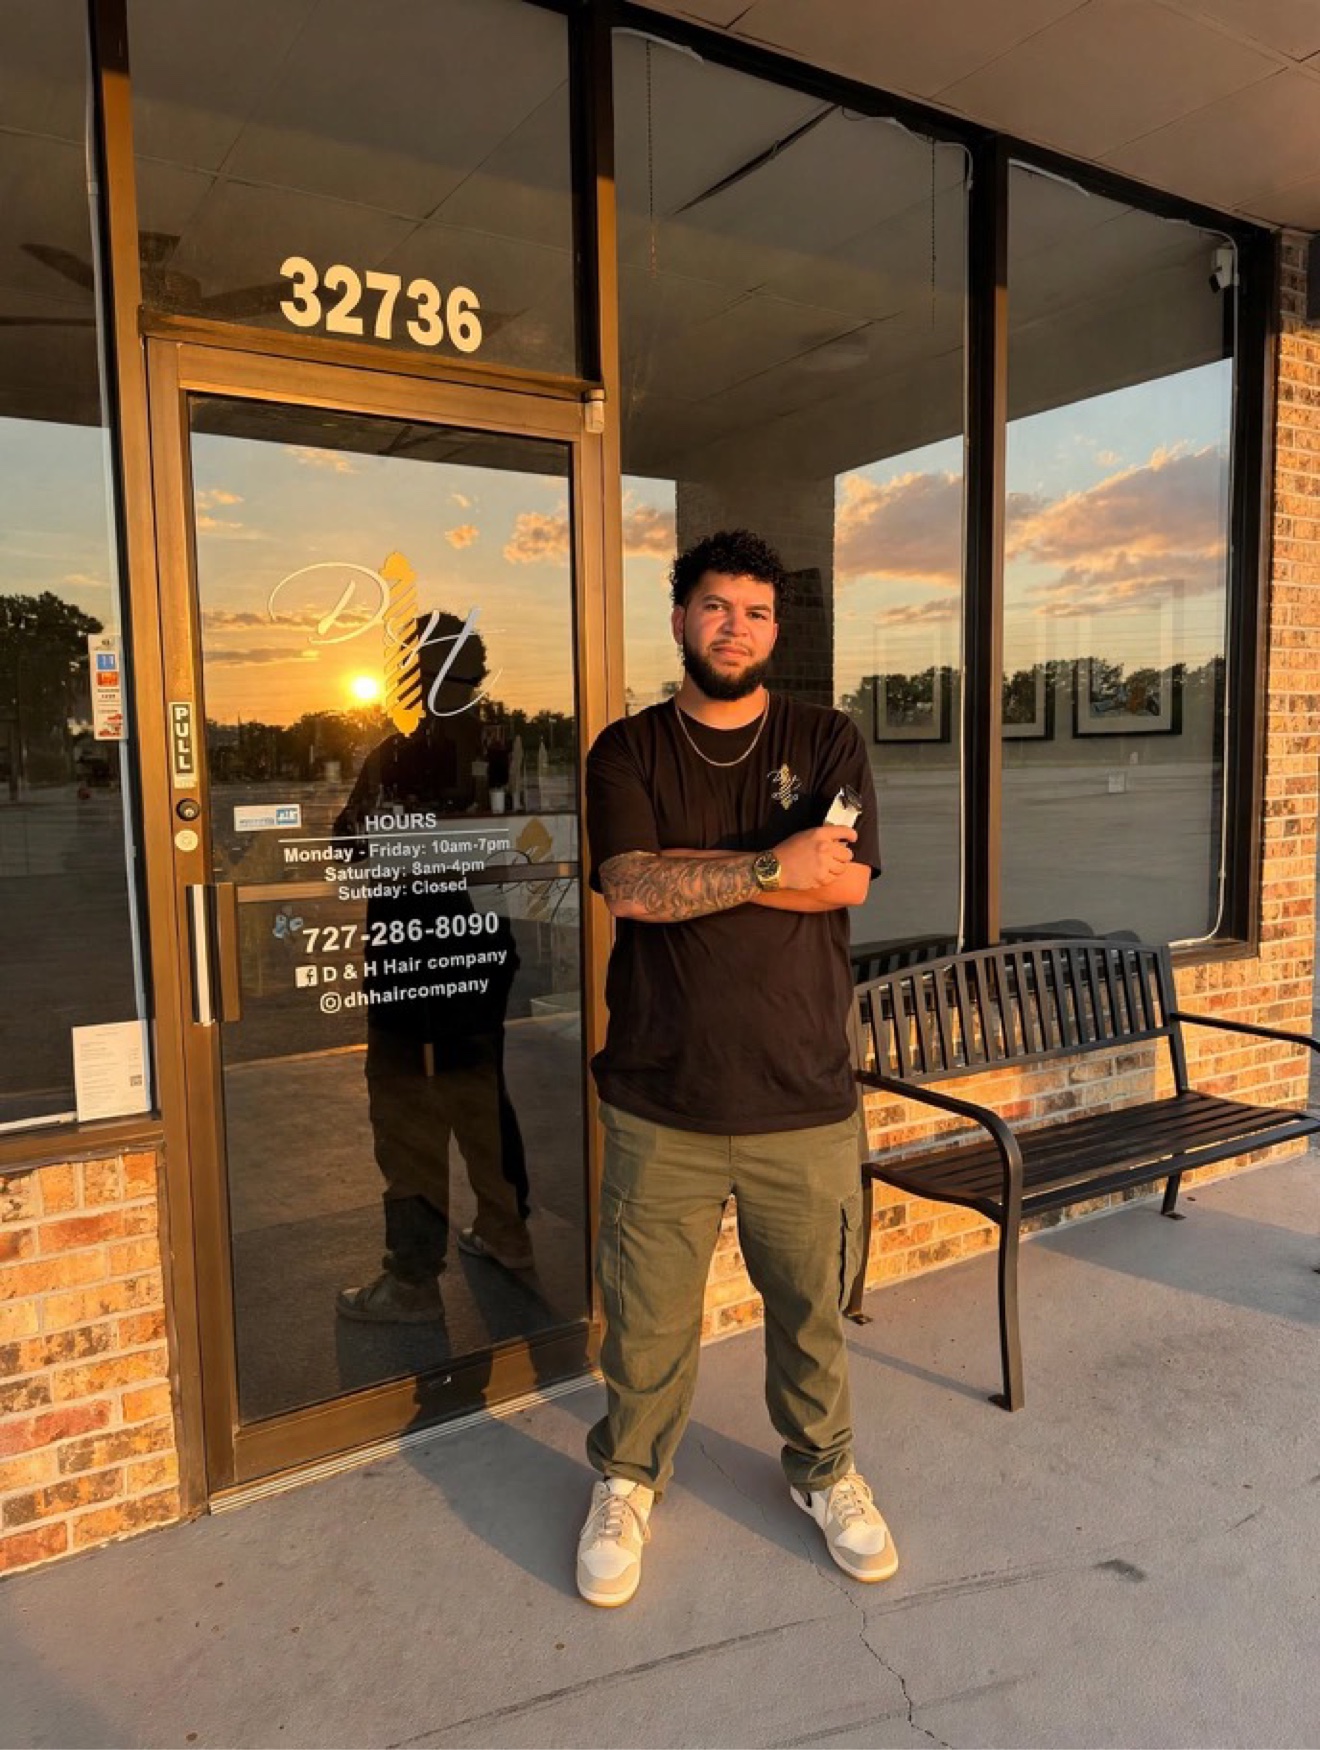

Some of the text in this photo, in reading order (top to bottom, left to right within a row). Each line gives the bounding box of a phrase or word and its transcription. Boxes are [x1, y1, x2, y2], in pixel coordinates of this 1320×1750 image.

[279, 256, 483, 353] 32736
[175, 707, 191, 770] PULL
[364, 813, 437, 832] HOURS
[283, 845, 354, 864] Monday
[368, 842, 427, 858] Friday:
[431, 837, 511, 855] 10am-7pm
[323, 859, 485, 883] Saturday: 8am-4pm
[411, 877, 468, 895] Closed
[302, 911, 499, 953] 727-286-8090
[322, 966, 337, 983] D
[343, 964, 358, 980] &
[363, 960, 377, 978] H
[383, 956, 422, 975] Hair
[426, 949, 508, 969] company
